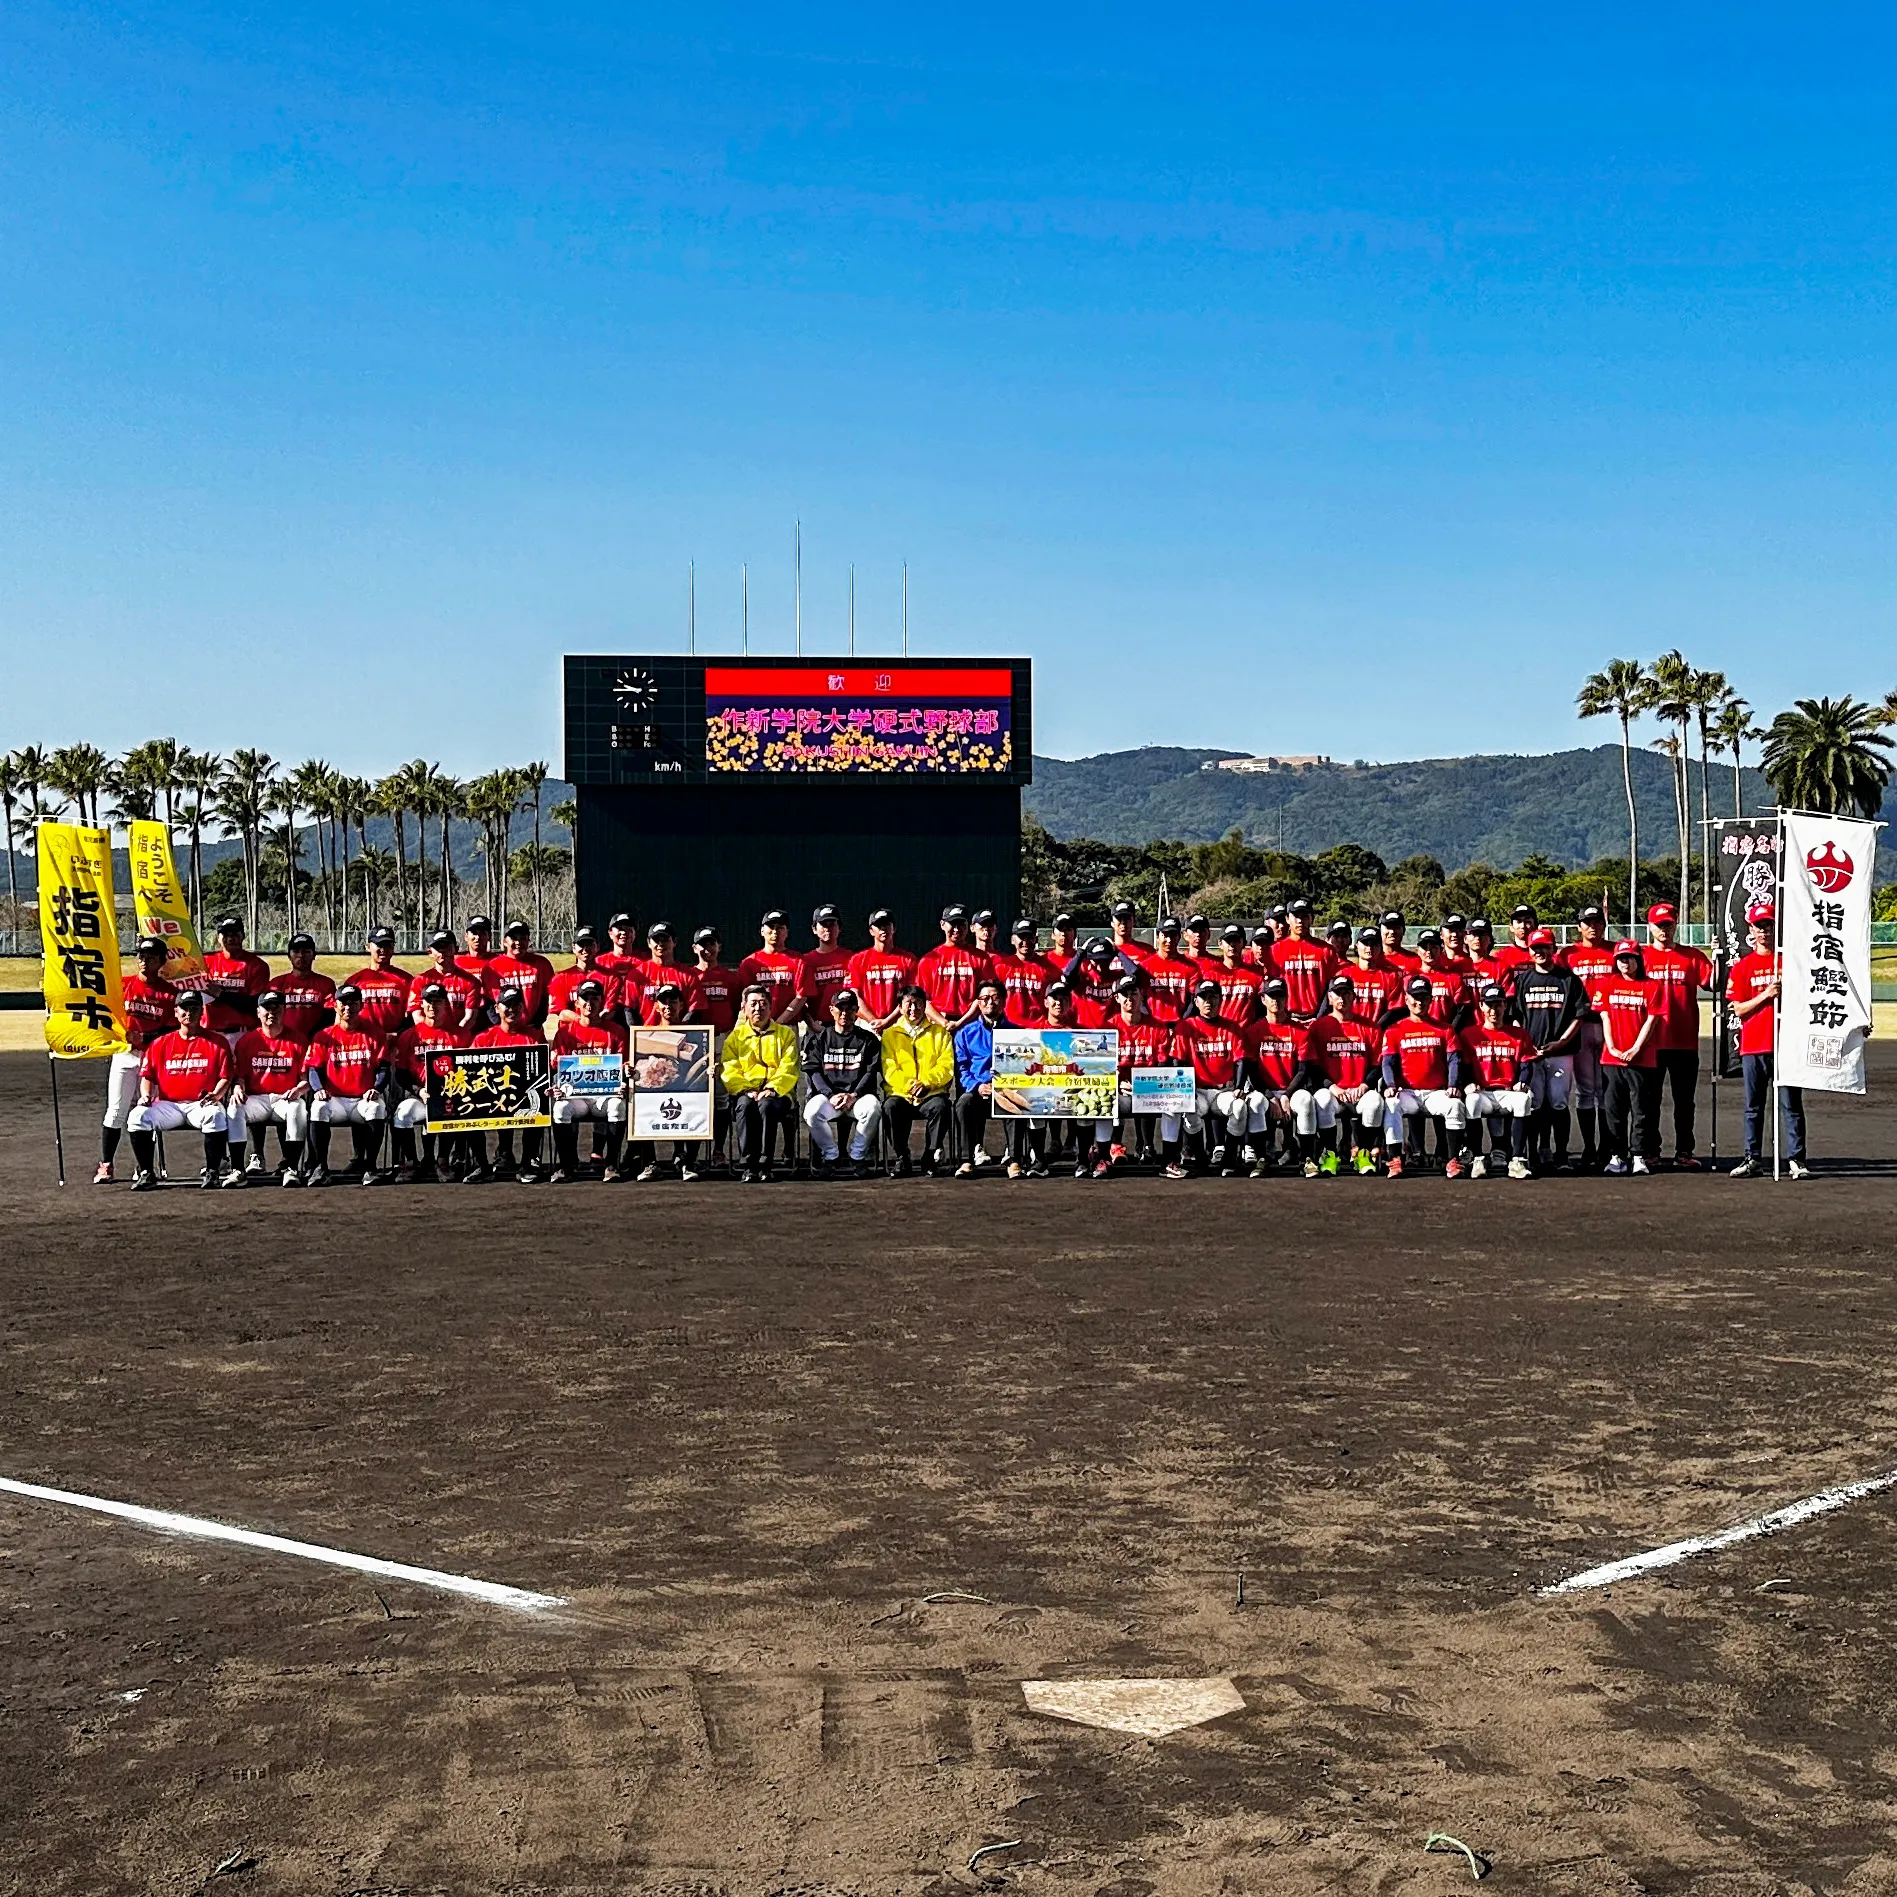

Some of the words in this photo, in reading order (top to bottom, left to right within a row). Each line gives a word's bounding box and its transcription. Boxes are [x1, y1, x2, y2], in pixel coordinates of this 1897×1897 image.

[828, 674, 891, 691] 歓迎
[721, 708, 998, 734] 作新学院大学硬式野球部
[783, 746, 868, 758] SAKUSHIN
[873, 746, 938, 758] GAKUIN
[654, 761, 682, 772] km/h
[150, 837, 174, 904] ようこそ
[143, 917, 181, 936] We
[52, 885, 114, 1031] 指宿市
[1809, 900, 1849, 1030] 指宿鰹節
[440, 1065, 521, 1098] 勝武士
[457, 1093, 527, 1116] ラーメン
